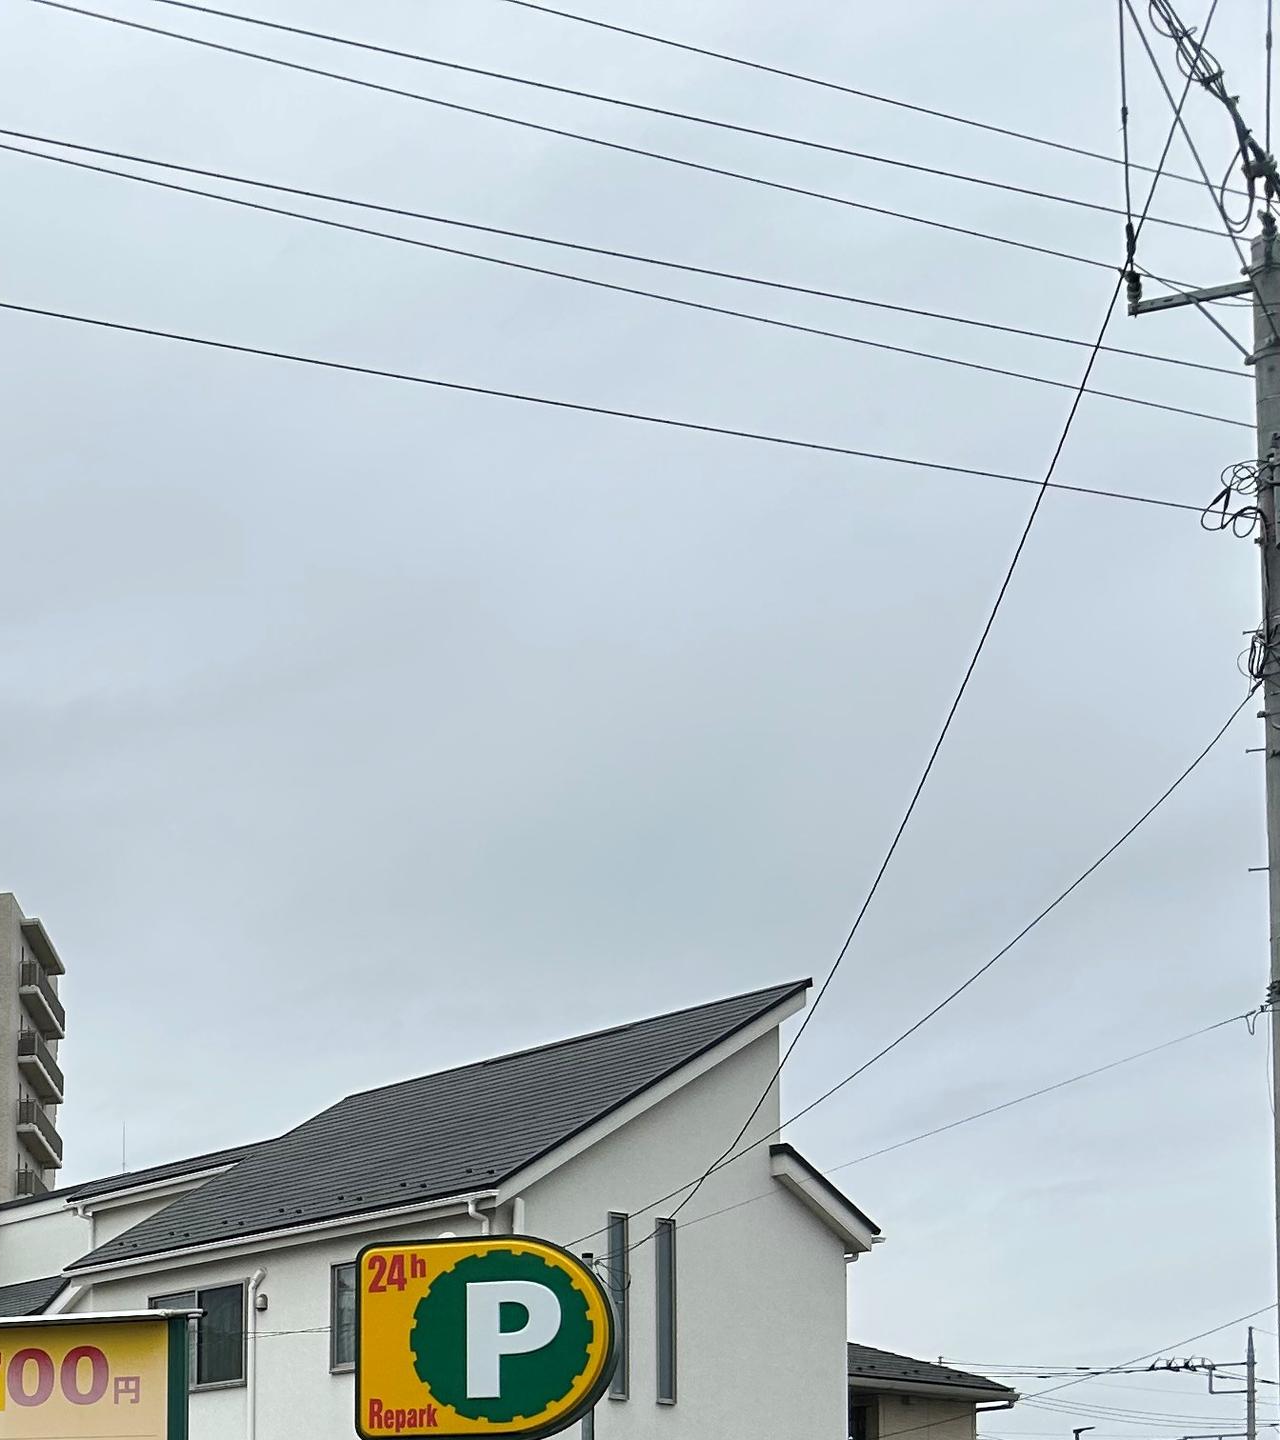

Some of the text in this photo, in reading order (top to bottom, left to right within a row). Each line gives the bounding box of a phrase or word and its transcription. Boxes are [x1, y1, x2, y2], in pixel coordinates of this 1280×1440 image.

[367, 1254, 427, 1294] 24h
[465, 1280, 562, 1399] P
[368, 1398, 438, 1433] Repark
